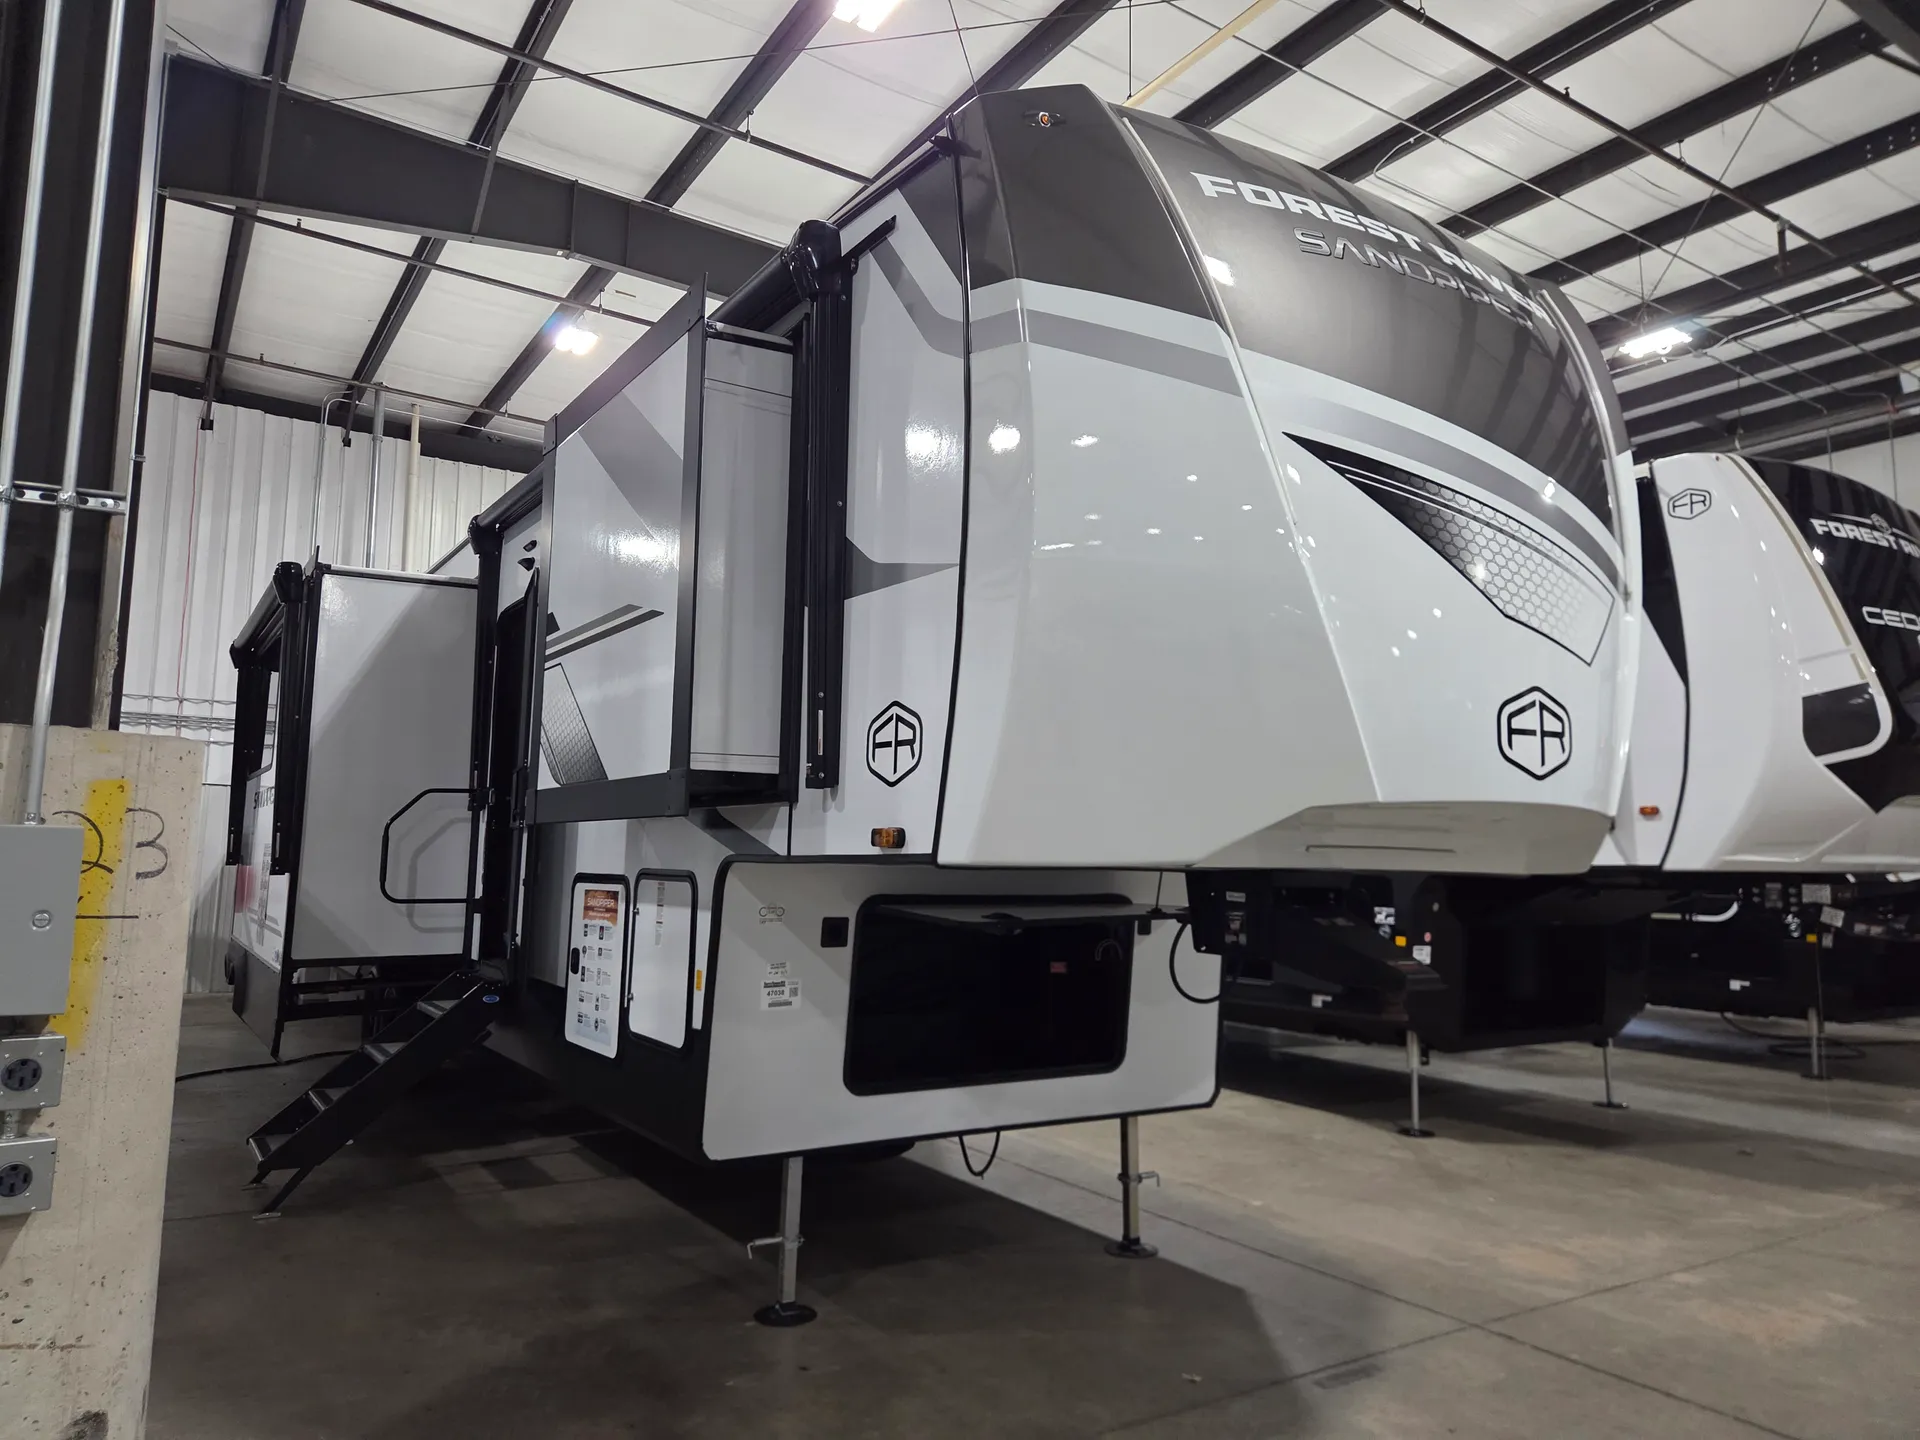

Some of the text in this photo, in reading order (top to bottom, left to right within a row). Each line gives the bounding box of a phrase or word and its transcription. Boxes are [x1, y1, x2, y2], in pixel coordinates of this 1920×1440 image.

[1189, 171, 1557, 330] FOREST RIVER
[1293, 226, 1534, 330] SANDPIPER
[1809, 518, 1898, 550] FOREST
[1862, 605, 1920, 631] CED
[1505, 697, 1567, 769] FR
